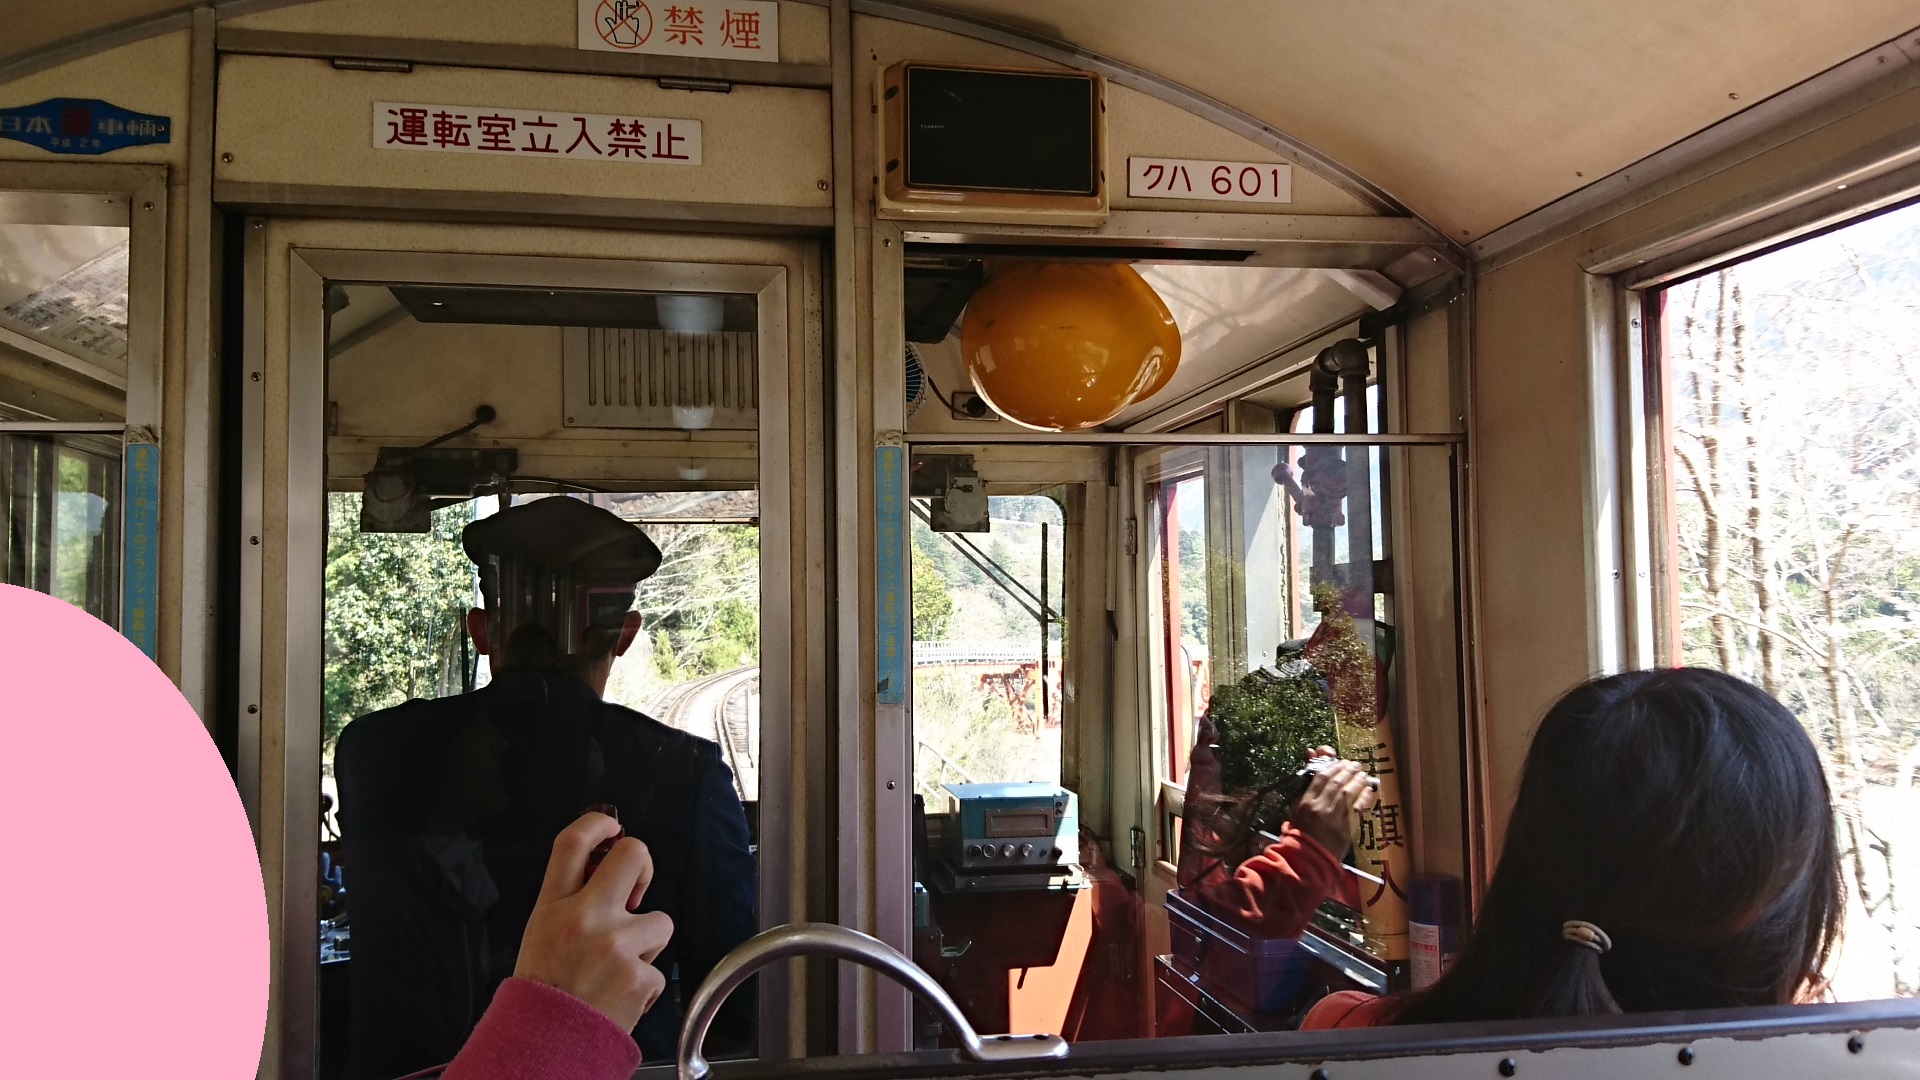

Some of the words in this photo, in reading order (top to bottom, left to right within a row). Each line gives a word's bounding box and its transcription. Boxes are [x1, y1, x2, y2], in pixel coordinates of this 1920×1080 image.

[663, 5, 762, 50] 禁煙
[0, 116, 52, 134] 日本
[386, 107, 690, 161] 運転室立入禁止
[1142, 164, 1192, 192] クハ
[1211, 165, 1279, 198] 601
